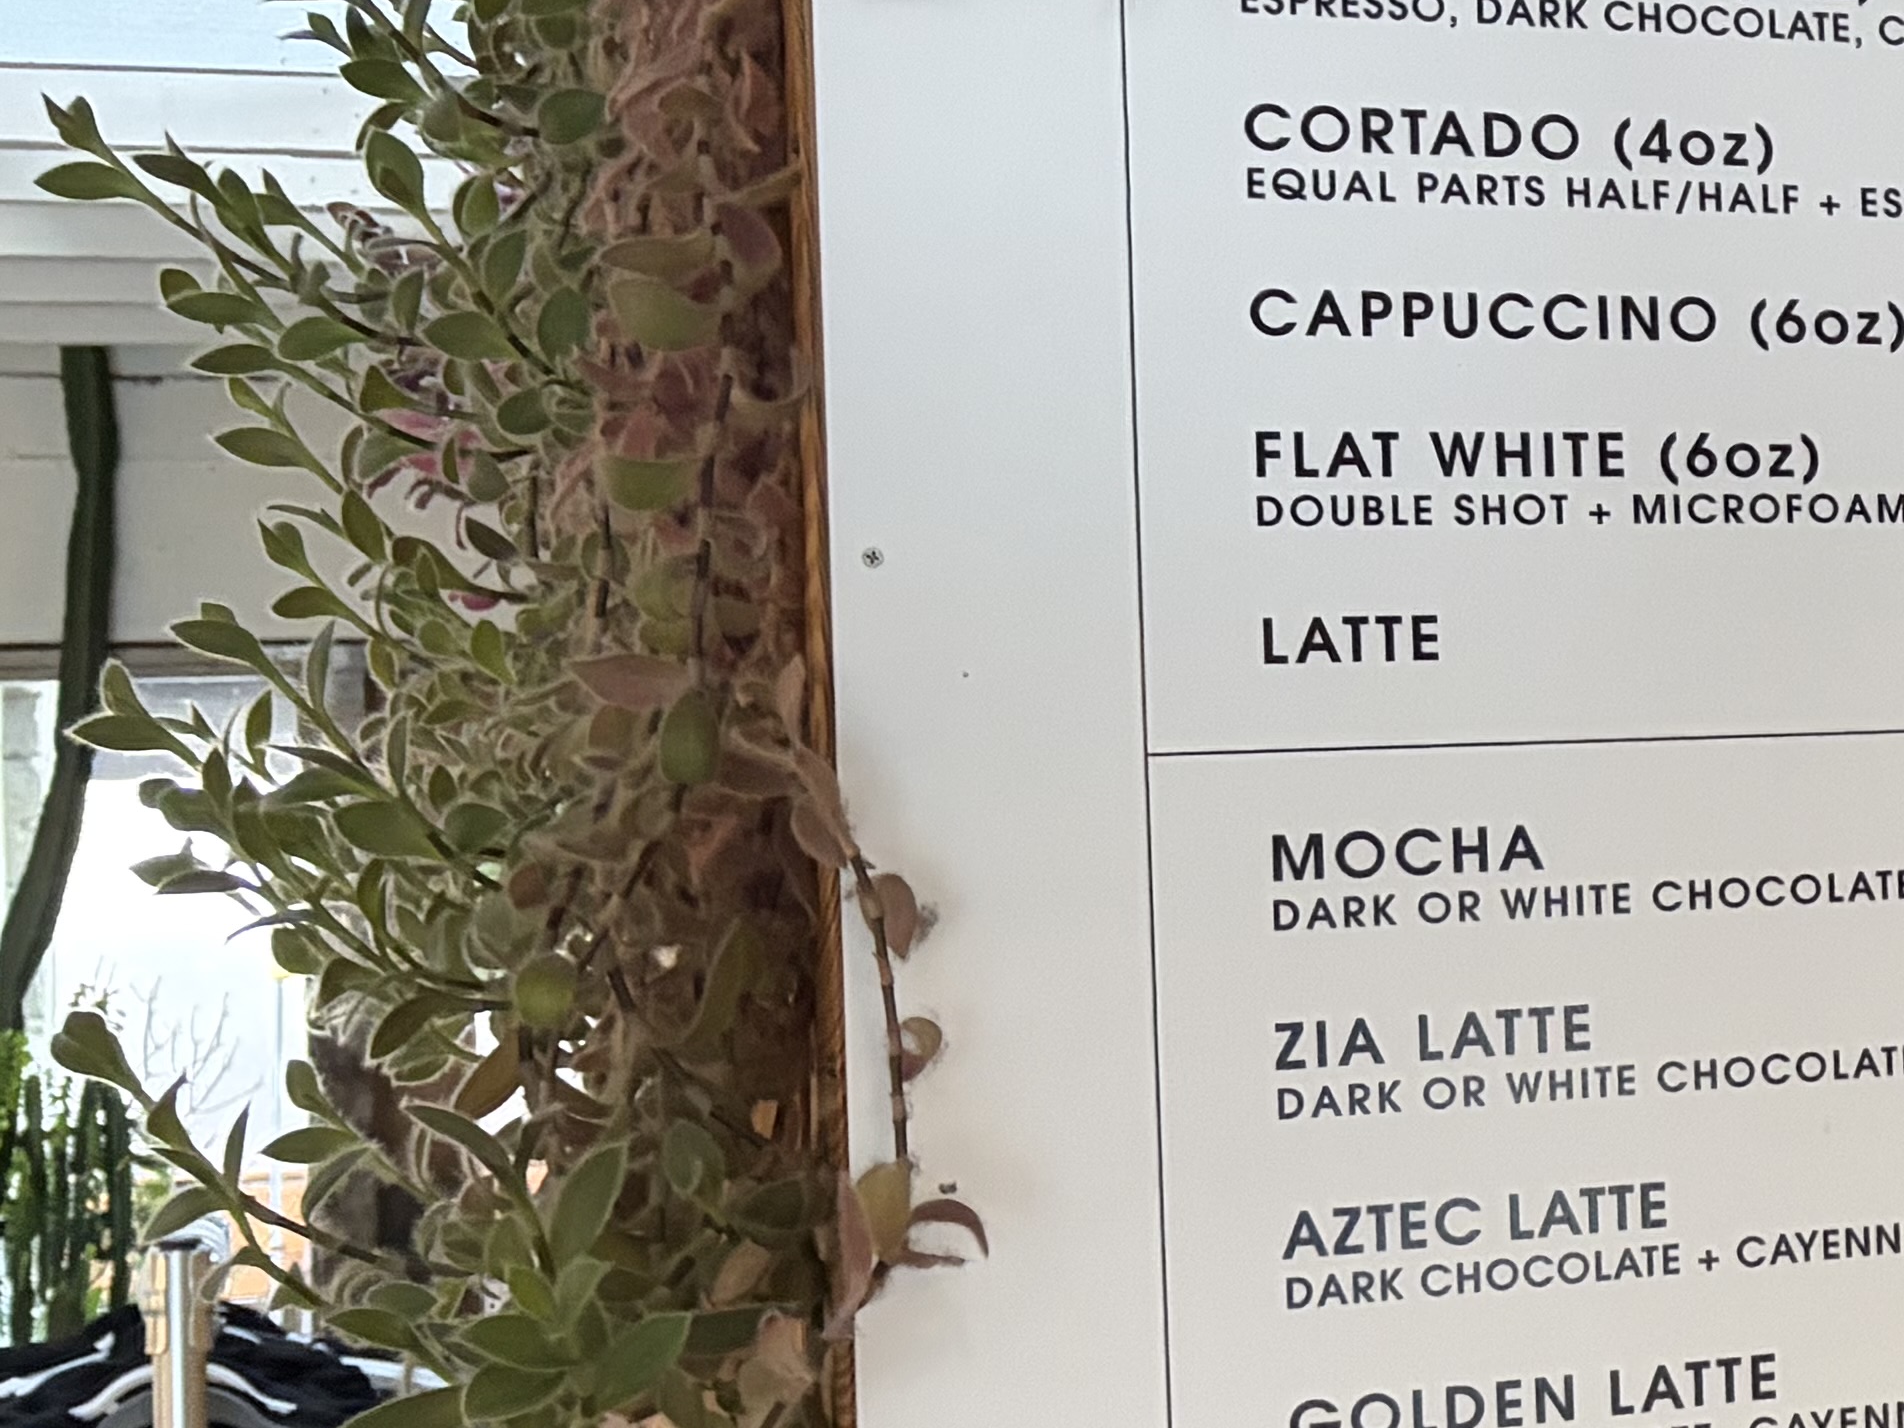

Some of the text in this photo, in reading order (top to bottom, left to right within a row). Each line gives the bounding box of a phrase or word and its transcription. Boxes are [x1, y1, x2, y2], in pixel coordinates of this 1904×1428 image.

[1242, 101, 1775, 177] CORTADO (4oz)
[1245, 165, 1398, 204] EQUAL
[1416, 170, 1547, 209] PARTS
[1565, 175, 1800, 216] HALF/HALF
[1248, 287, 1718, 344] CAPPUCCINO
[1261, 613, 1441, 666] LATTE
[1270, 823, 1546, 884] MOCHA
[1271, 892, 1399, 933] DARK
[1416, 888, 1482, 926] OR
[1498, 881, 1632, 921] WHITE
[1280, 1180, 1669, 1262] AZTEC LATTE
